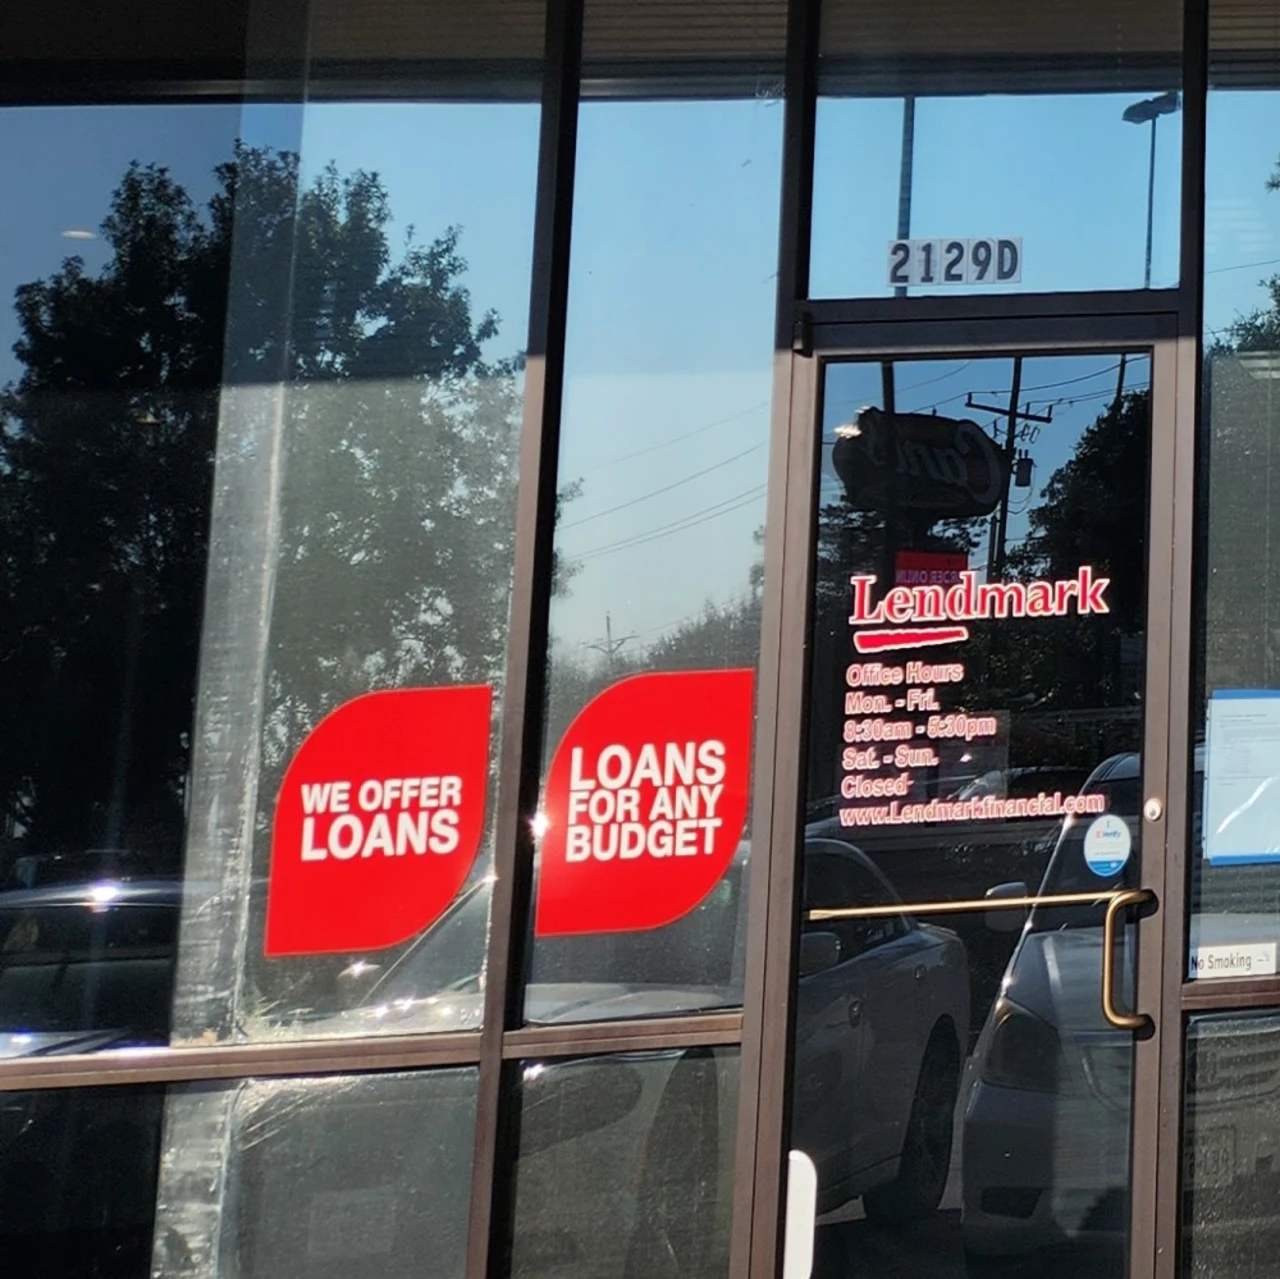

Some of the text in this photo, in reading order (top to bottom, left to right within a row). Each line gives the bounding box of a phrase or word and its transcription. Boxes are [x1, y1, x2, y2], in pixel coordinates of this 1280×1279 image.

[889, 239, 1019, 284] 2129D
[849, 566, 1110, 625] Lendmark
[846, 661, 964, 687] Office Hours
[845, 692, 893, 715] Mon.
[907, 688, 941, 711] Fri.
[843, 719, 913, 743] 8:30am
[927, 714, 997, 741] 5:30pm
[569, 740, 727, 790] LOANS
[842, 747, 881, 770] Sat.
[895, 744, 939, 767] Sun.
[301, 776, 462, 814] WE OFFER
[841, 772, 910, 798] Closed
[568, 784, 723, 825] FOR ANY
[839, 791, 1105, 827] www.Lendmarkfinancial.com
[301, 810, 461, 861] LOANS
[566, 818, 723, 862] BUDGET
[1191, 952, 1252, 971] No Smoking
